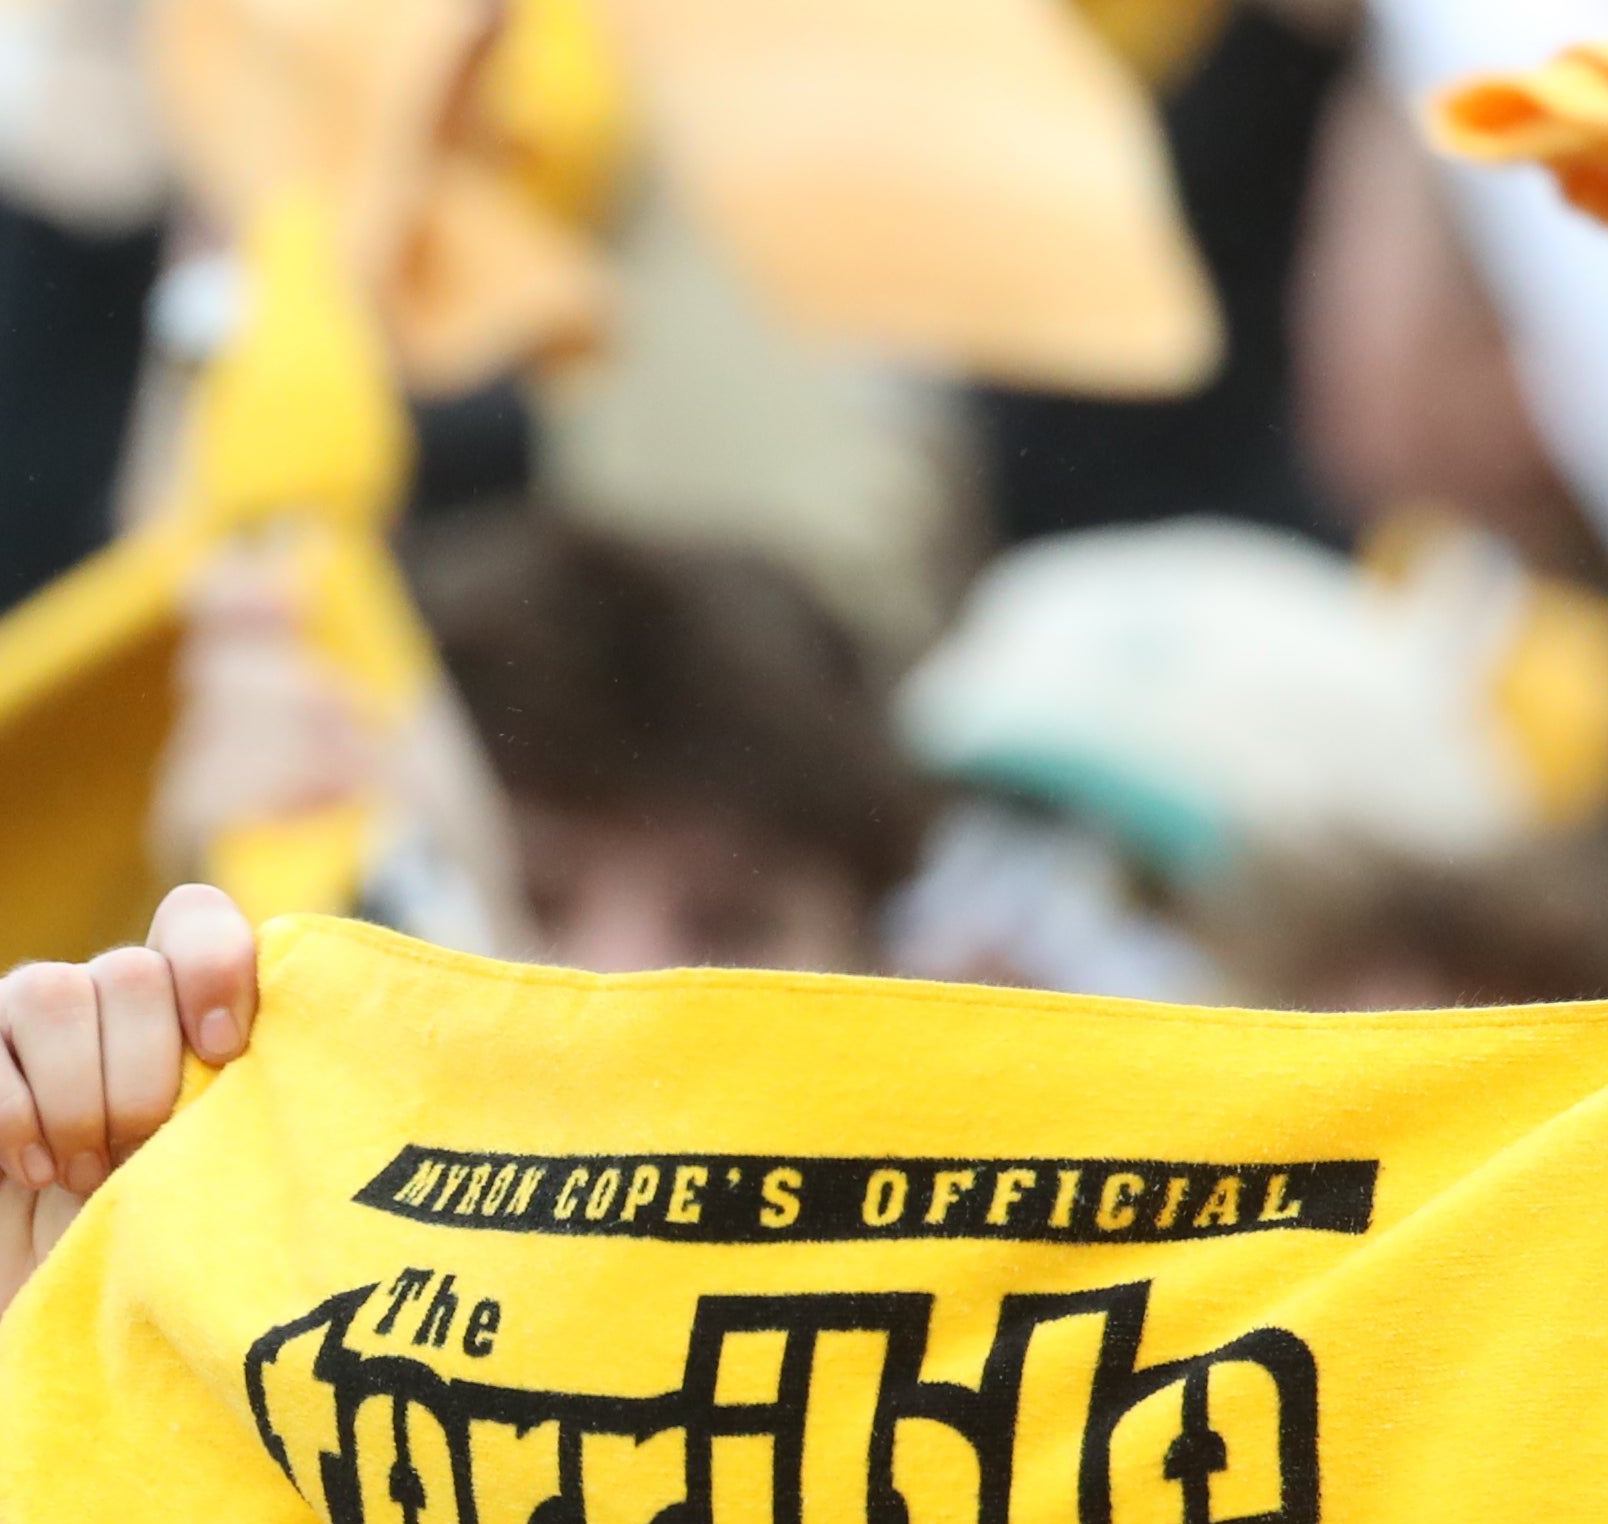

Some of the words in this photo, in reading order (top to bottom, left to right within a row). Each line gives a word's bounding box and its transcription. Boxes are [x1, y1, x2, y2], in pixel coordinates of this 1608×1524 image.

[393, 1158, 545, 1217] MYRON
[554, 1163, 803, 1229] COPE'S
[861, 1167, 1301, 1232] OFFICIAL
[373, 1266, 501, 1359] The
